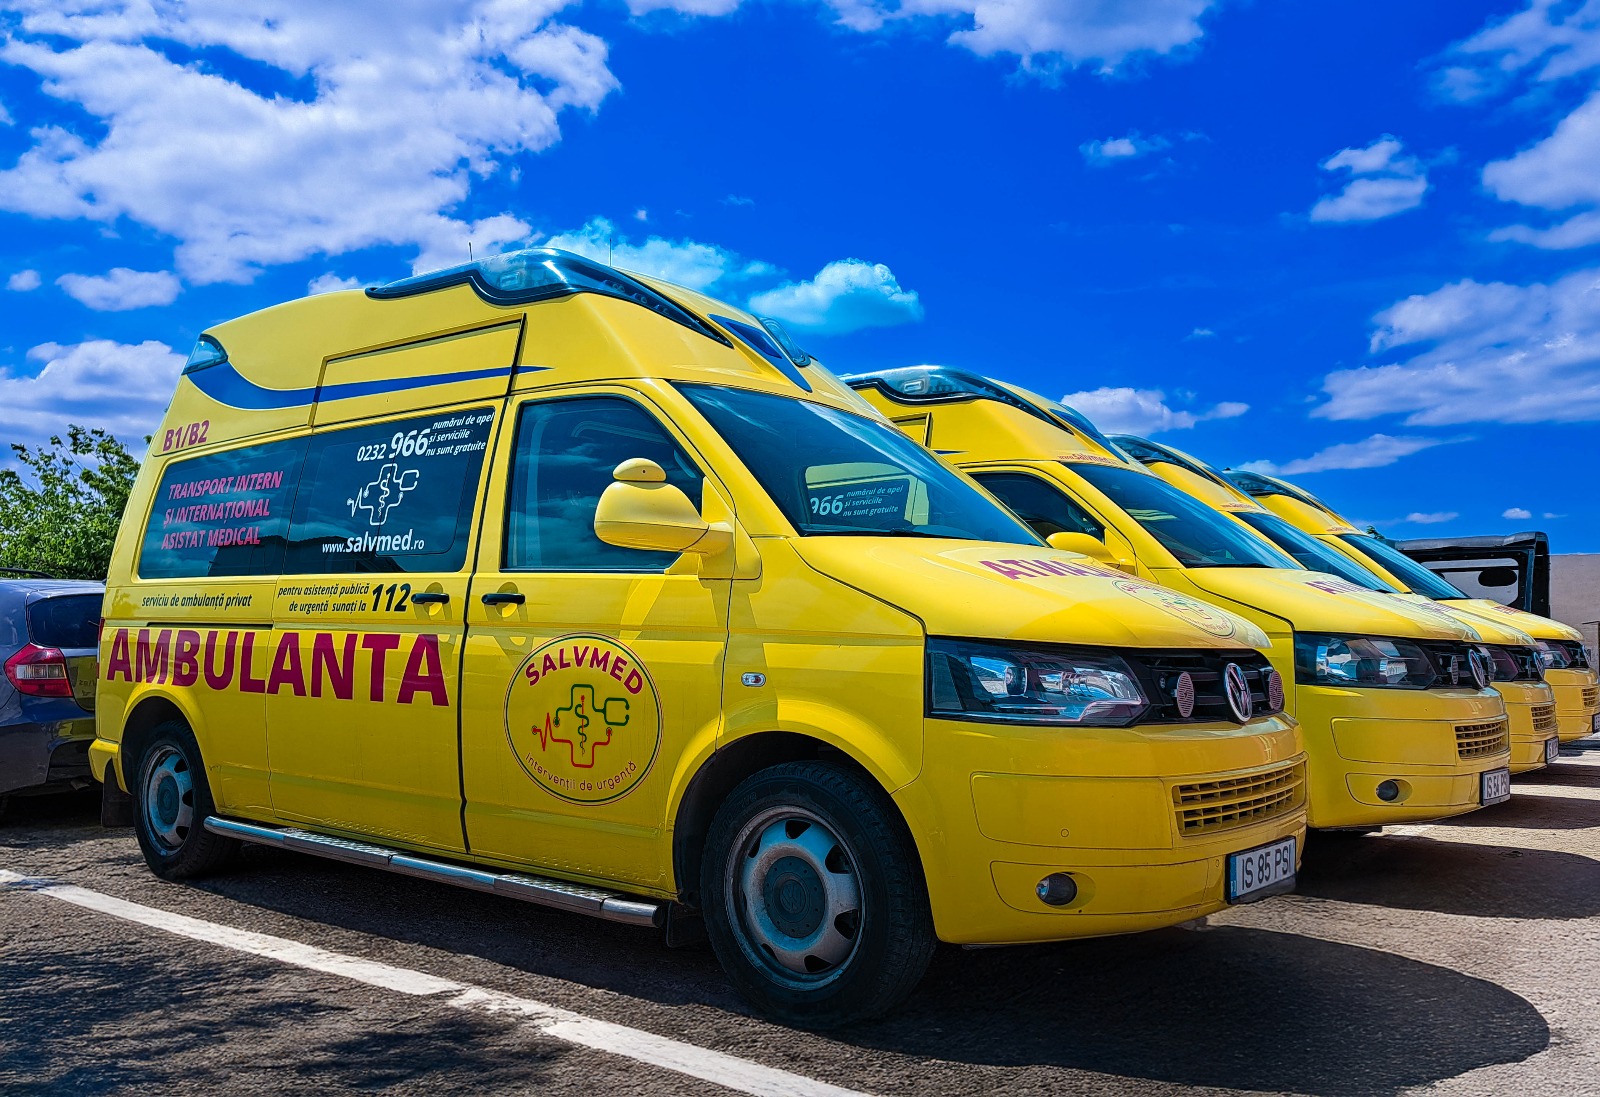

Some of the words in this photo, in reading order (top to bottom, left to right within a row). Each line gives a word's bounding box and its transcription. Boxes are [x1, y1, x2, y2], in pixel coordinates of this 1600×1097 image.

[432, 417, 465, 430] numărul
[465, 414, 475, 426] de
[476, 411, 495, 426] apel
[162, 419, 210, 452] B1/B2
[356, 443, 387, 462] 0232
[388, 428, 431, 459] 966
[436, 428, 471, 442] serviciile
[425, 448, 435, 457] nu
[436, 444, 453, 455] sunt
[454, 441, 487, 456] gratuite
[168, 476, 234, 500] TRANSPORT
[234, 470, 284, 493] INTERN
[877, 486, 886, 495] de
[886, 485, 904, 494] apel
[175, 498, 271, 525] INTERNAȚIONAL
[853, 507, 869, 516] sunt
[869, 504, 899, 517] gratuite
[160, 529, 206, 550] ASISTAT
[207, 527, 261, 548] MEDICAL
[322, 529, 425, 554] www.salvmed.ro
[141, 593, 168, 607] serviciu
[170, 593, 179, 607] de
[180, 593, 225, 610] ambulanță
[225, 592, 253, 610] privat
[277, 585, 302, 599] pentru
[303, 583, 339, 598] asistență
[339, 583, 371, 598] publică
[371, 583, 412, 612] 112
[289, 600, 299, 612] de
[299, 600, 329, 615] urgență
[331, 600, 357, 615] sunați
[358, 600, 367, 612] la
[106, 627, 450, 707] AMBULANTA
[524, 645, 644, 695] SALVMED
[525, 752, 577, 791] intervenții
[579, 779, 593, 791] de
[596, 760, 637, 790] urgență
[1241, 857, 1254, 891] IS
[1257, 851, 1271, 884] 85
[1275, 842, 1292, 881] PSI
